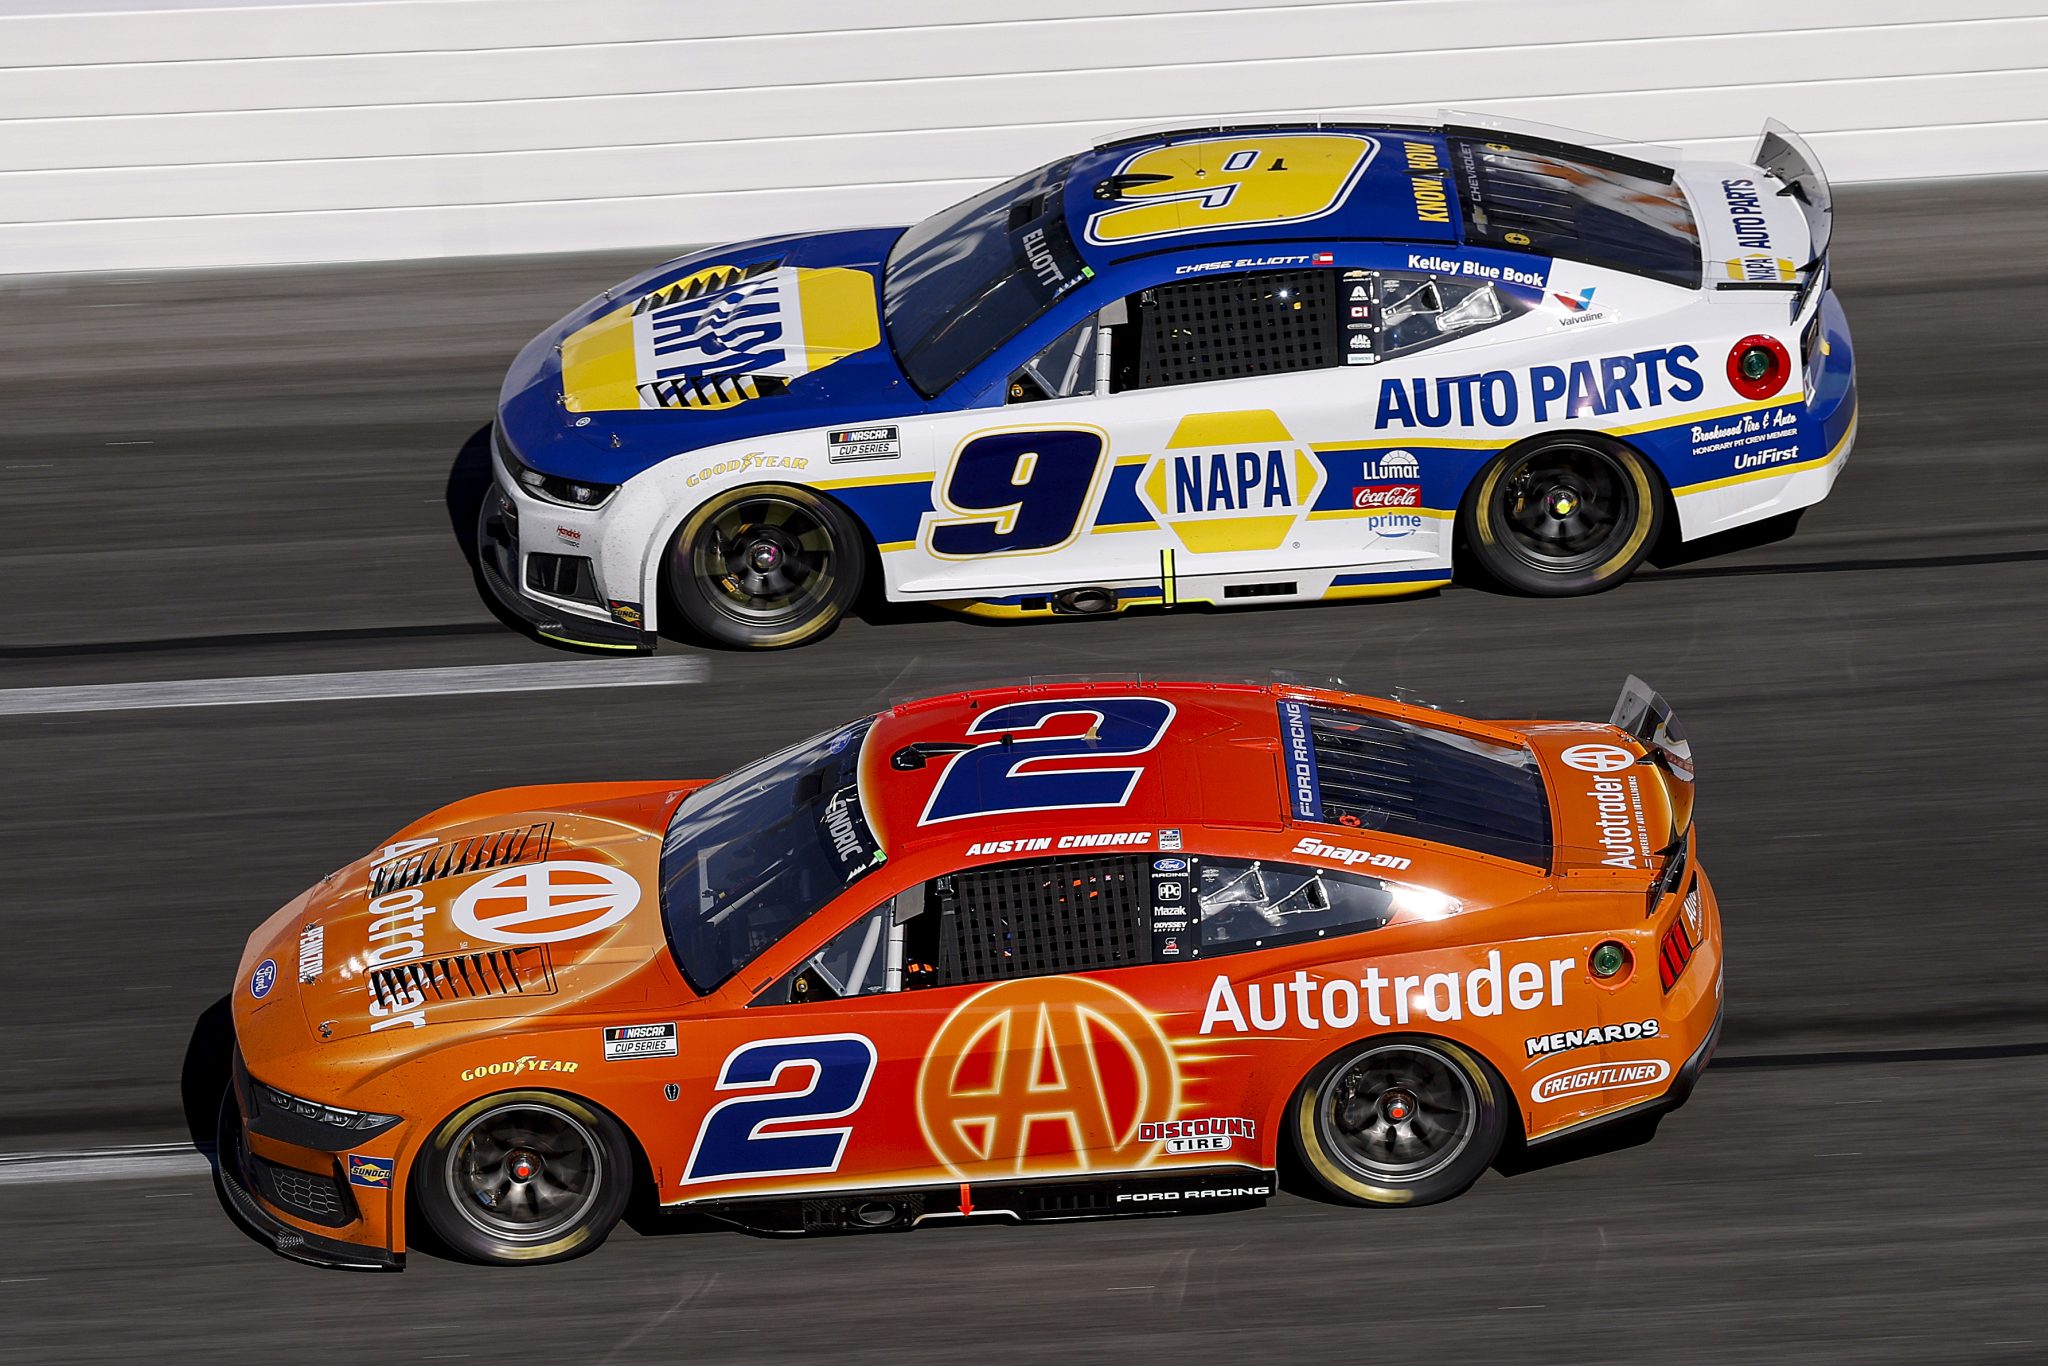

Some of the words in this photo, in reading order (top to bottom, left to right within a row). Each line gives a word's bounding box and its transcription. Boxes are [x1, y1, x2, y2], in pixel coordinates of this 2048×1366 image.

[1403, 142, 1439, 169] HOW
[1460, 142, 1482, 202] CHEVROLET
[1084, 132, 1381, 246] 9
[1411, 178, 1450, 222] KNOW
[1721, 179, 1762, 214] PARTS
[1732, 217, 1771, 249] AUTO
[1022, 228, 1064, 286] ELLIOTT
[1175, 260, 1233, 274] CHASE
[1235, 255, 1309, 267] ELLIOTT
[1408, 255, 1460, 276] Kelley
[1463, 261, 1500, 279] Blue
[1503, 267, 1544, 287] Book
[1559, 312, 1603, 326] Valvoline
[1374, 370, 1518, 429] AUTO
[1529, 344, 1704, 423] PARTS
[850, 429, 888, 441] NASCAR
[1691, 420, 1742, 443] Brookwood
[1742, 415, 1760, 433] Tire
[1763, 411, 1769, 429] &
[1773, 408, 1797, 427] Auto
[839, 445, 858, 455] CUP
[859, 443, 889, 454] SERIES
[1692, 442, 1733, 455] HONORARY
[1734, 438, 1745, 447] PIT
[1745, 436, 1767, 445] CREW
[1767, 428, 1797, 441] MEMBER
[1734, 445, 1798, 469] UniFirst
[1175, 450, 1292, 513] NAPA
[1363, 462, 1420, 480] LLumar
[925, 422, 1111, 561] 9
[1368, 512, 1421, 531] prime
[1286, 702, 1309, 762] RACING
[917, 696, 1177, 827] 2
[1296, 763, 1315, 818] FORD
[825, 800, 863, 863] CINDRIC
[1587, 775, 1637, 869] Autotrader
[1634, 811, 1645, 825] AUTO
[965, 837, 1052, 856] AUSTIN
[1057, 831, 1151, 849] CINDRIC
[1292, 837, 1412, 870] Snap-on
[1638, 833, 1651, 857] POWERED
[1159, 860, 1180, 869] Ford
[1160, 884, 1180, 899] PPG
[1153, 921, 1187, 929] ODYSSEY
[1154, 906, 1187, 917] Mazak
[368, 837, 439, 1032] Aotraer
[255, 966, 274, 993] Ford
[1199, 950, 1575, 1035] Autotrader
[626, 1026, 665, 1038] NASCAR
[1526, 1019, 1660, 1057] MENARDS
[615, 1042, 634, 1053] CUP
[635, 1040, 666, 1051] SERIES
[1543, 1065, 1656, 1096] FREIGHTLINER
[681, 1033, 878, 1186] 2
[1139, 1117, 1256, 1142] DISCOUNT
[1173, 1138, 1223, 1150] TIRE
[352, 1166, 391, 1178] SUNOCO
[1116, 1192, 1179, 1202] FORD
[1185, 1187, 1269, 1199] RACING
